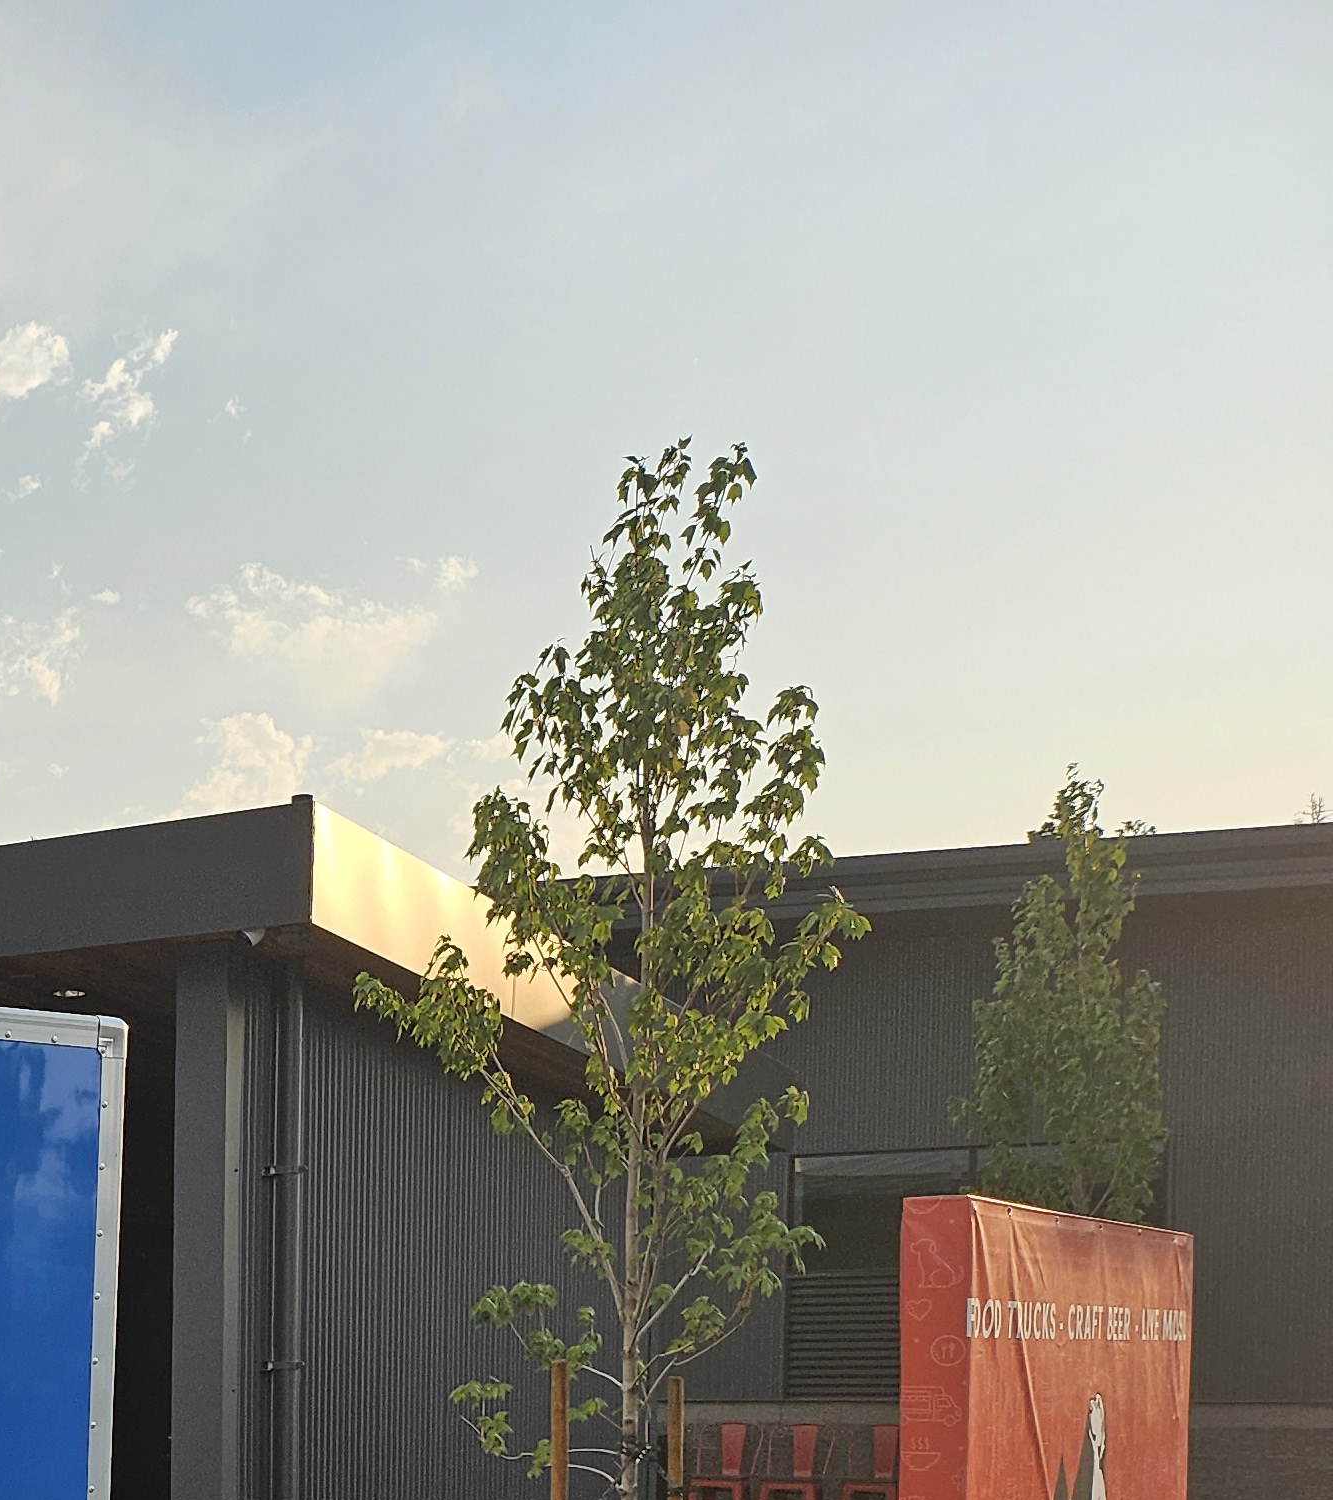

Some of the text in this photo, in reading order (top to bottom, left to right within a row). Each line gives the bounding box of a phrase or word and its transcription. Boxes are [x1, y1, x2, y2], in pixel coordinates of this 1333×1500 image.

[966, 1297, 1002, 1339] FOOD
[1007, 1300, 1056, 1340] TRUCKS
[1068, 1303, 1104, 1340] CRAFT
[1107, 1306, 1131, 1341] BEER
